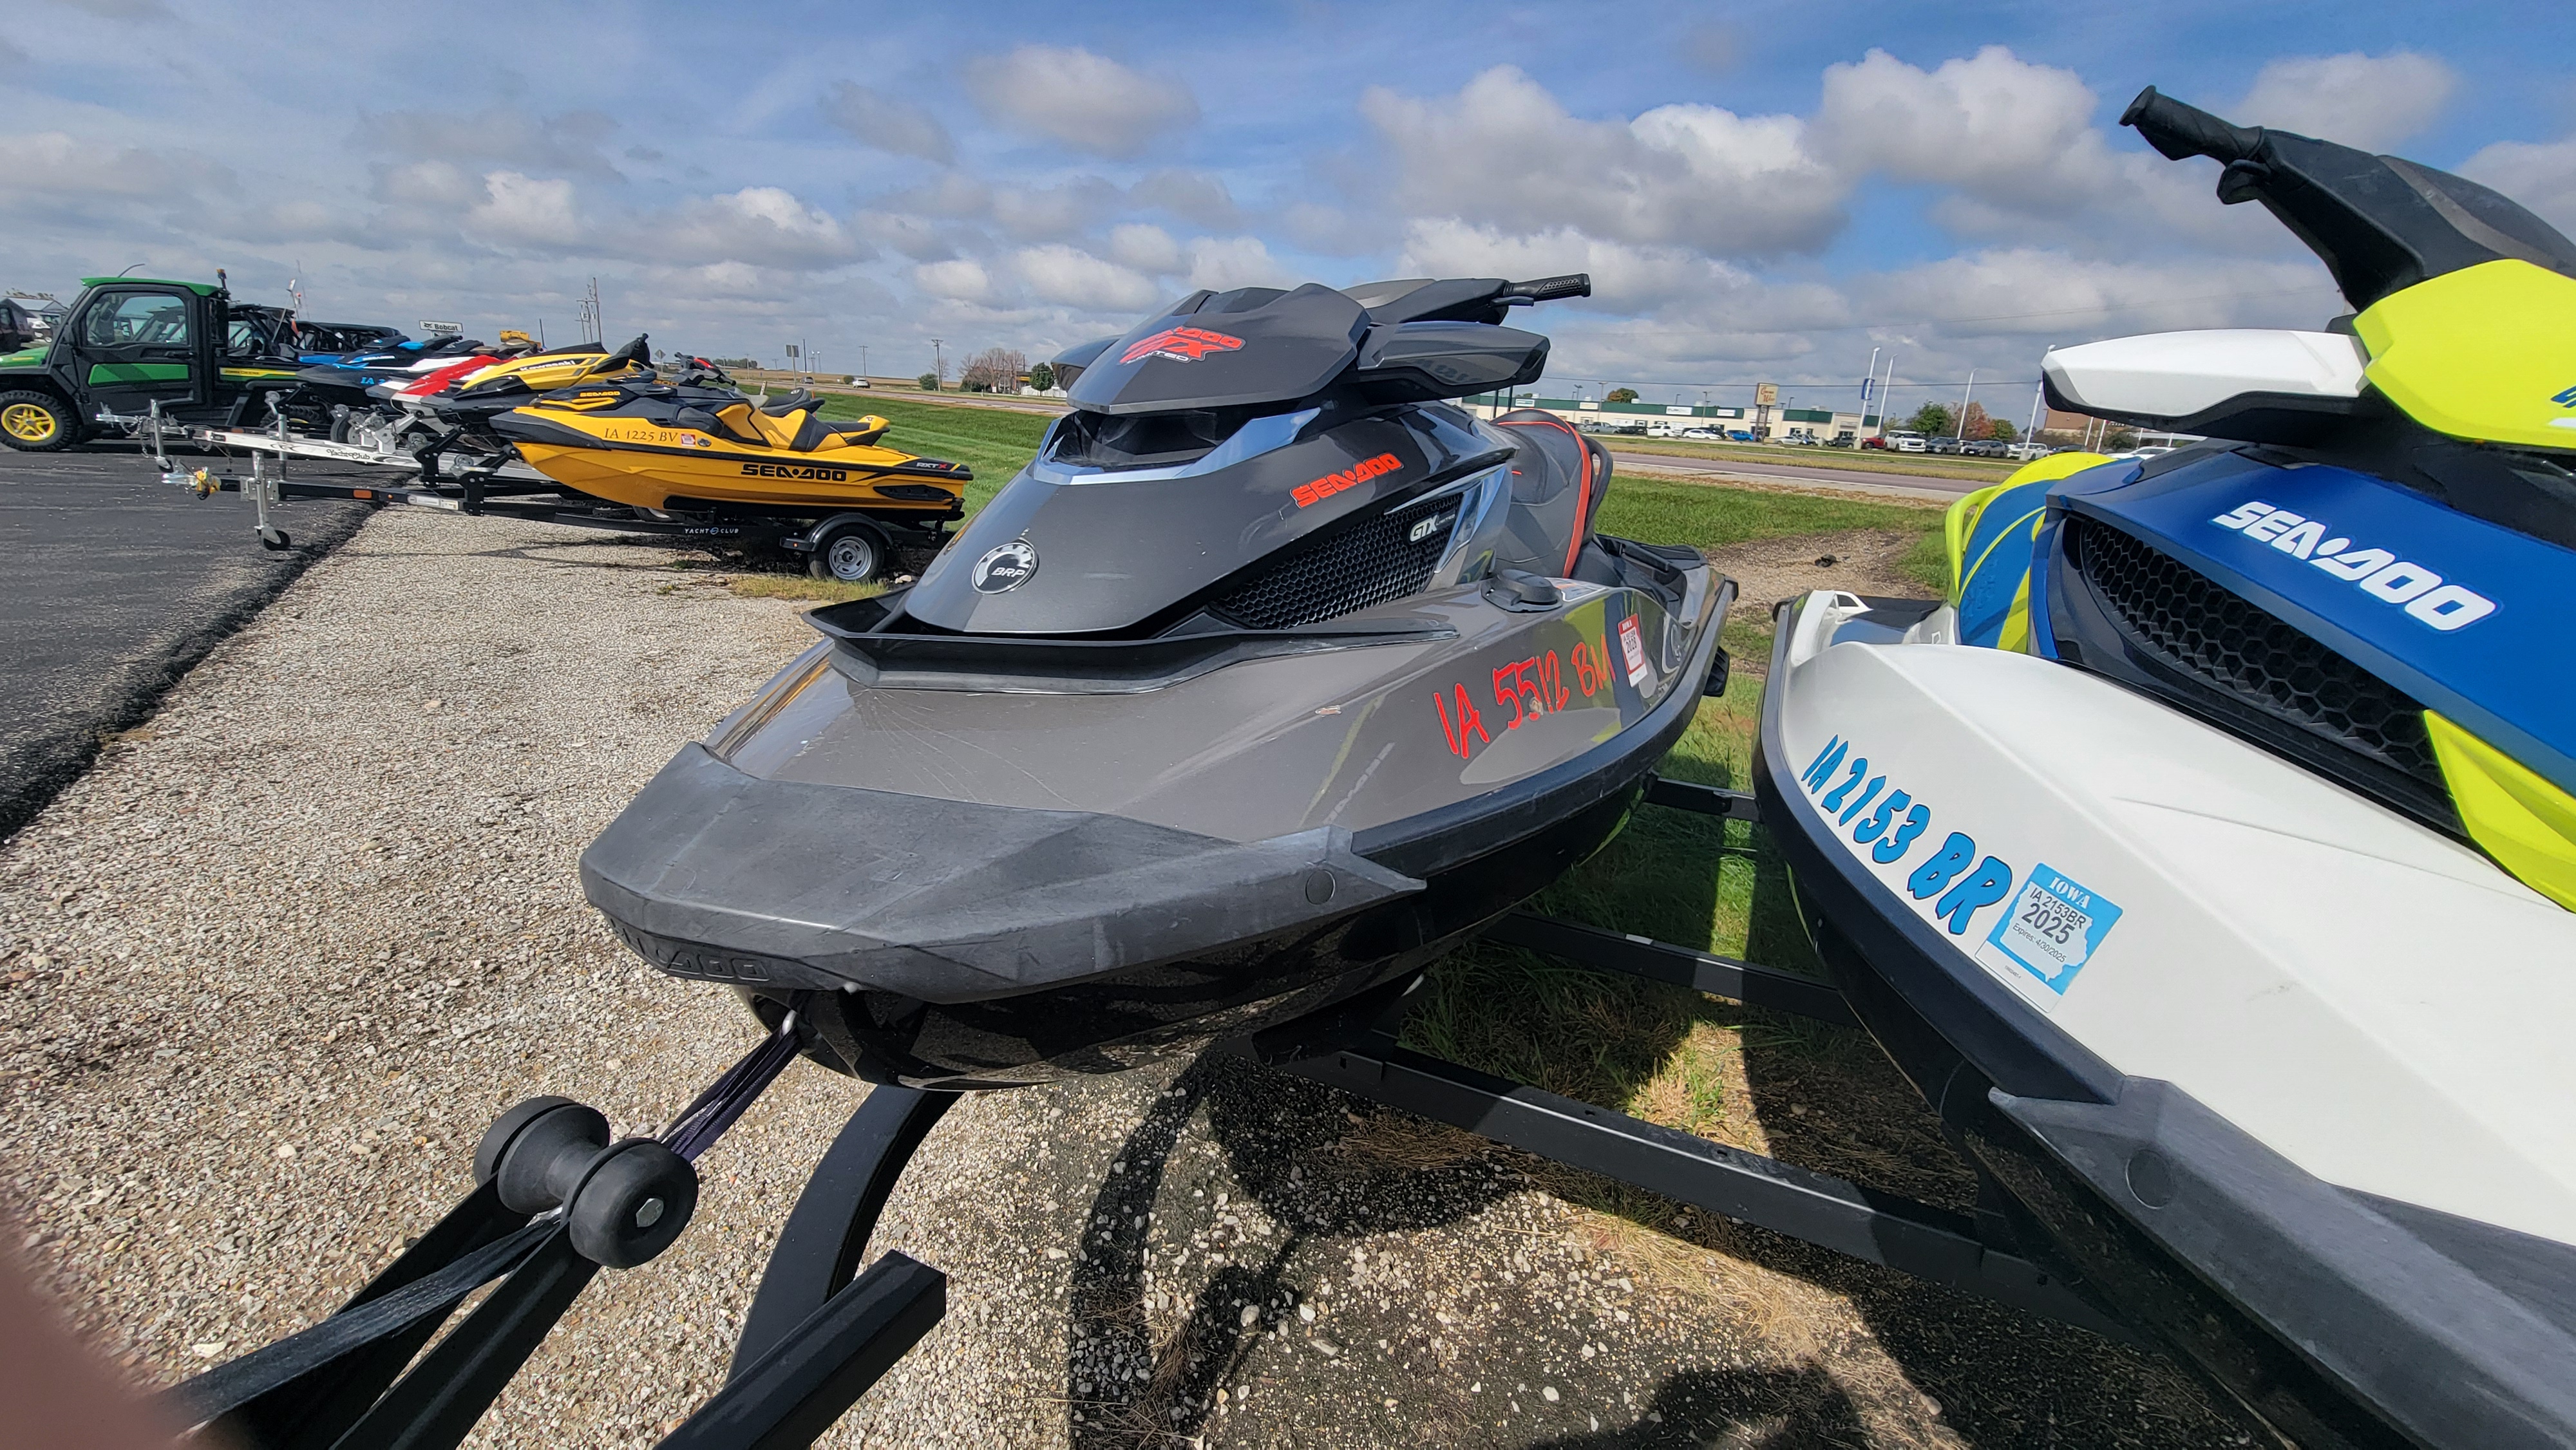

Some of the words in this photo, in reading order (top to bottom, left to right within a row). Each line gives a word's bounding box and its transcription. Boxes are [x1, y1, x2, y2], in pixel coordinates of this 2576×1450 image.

[360, 377, 375, 385] IA
[519, 360, 576, 372] Kawasaki
[604, 428, 620, 438] IA
[625, 430, 654, 442] 1225
[659, 431, 679, 442] BV
[1409, 514, 1437, 542] GTX
[990, 567, 1026, 578] BRP
[1433, 683, 1490, 760] IA
[1492, 649, 1570, 730] 5512
[1801, 734, 1848, 795] IA
[1821, 757, 1930, 863] 2153
[1907, 831, 2012, 935] BR
[2048, 876, 2091, 909] IOWA
[2021, 903, 2076, 944] 2025
[2029, 887, 2043, 903] IA
[2041, 896, 2087, 929] 2153BR
[2012, 923, 2037, 943] Expires:
[2035, 939, 2067, 963] 4/30/2025
